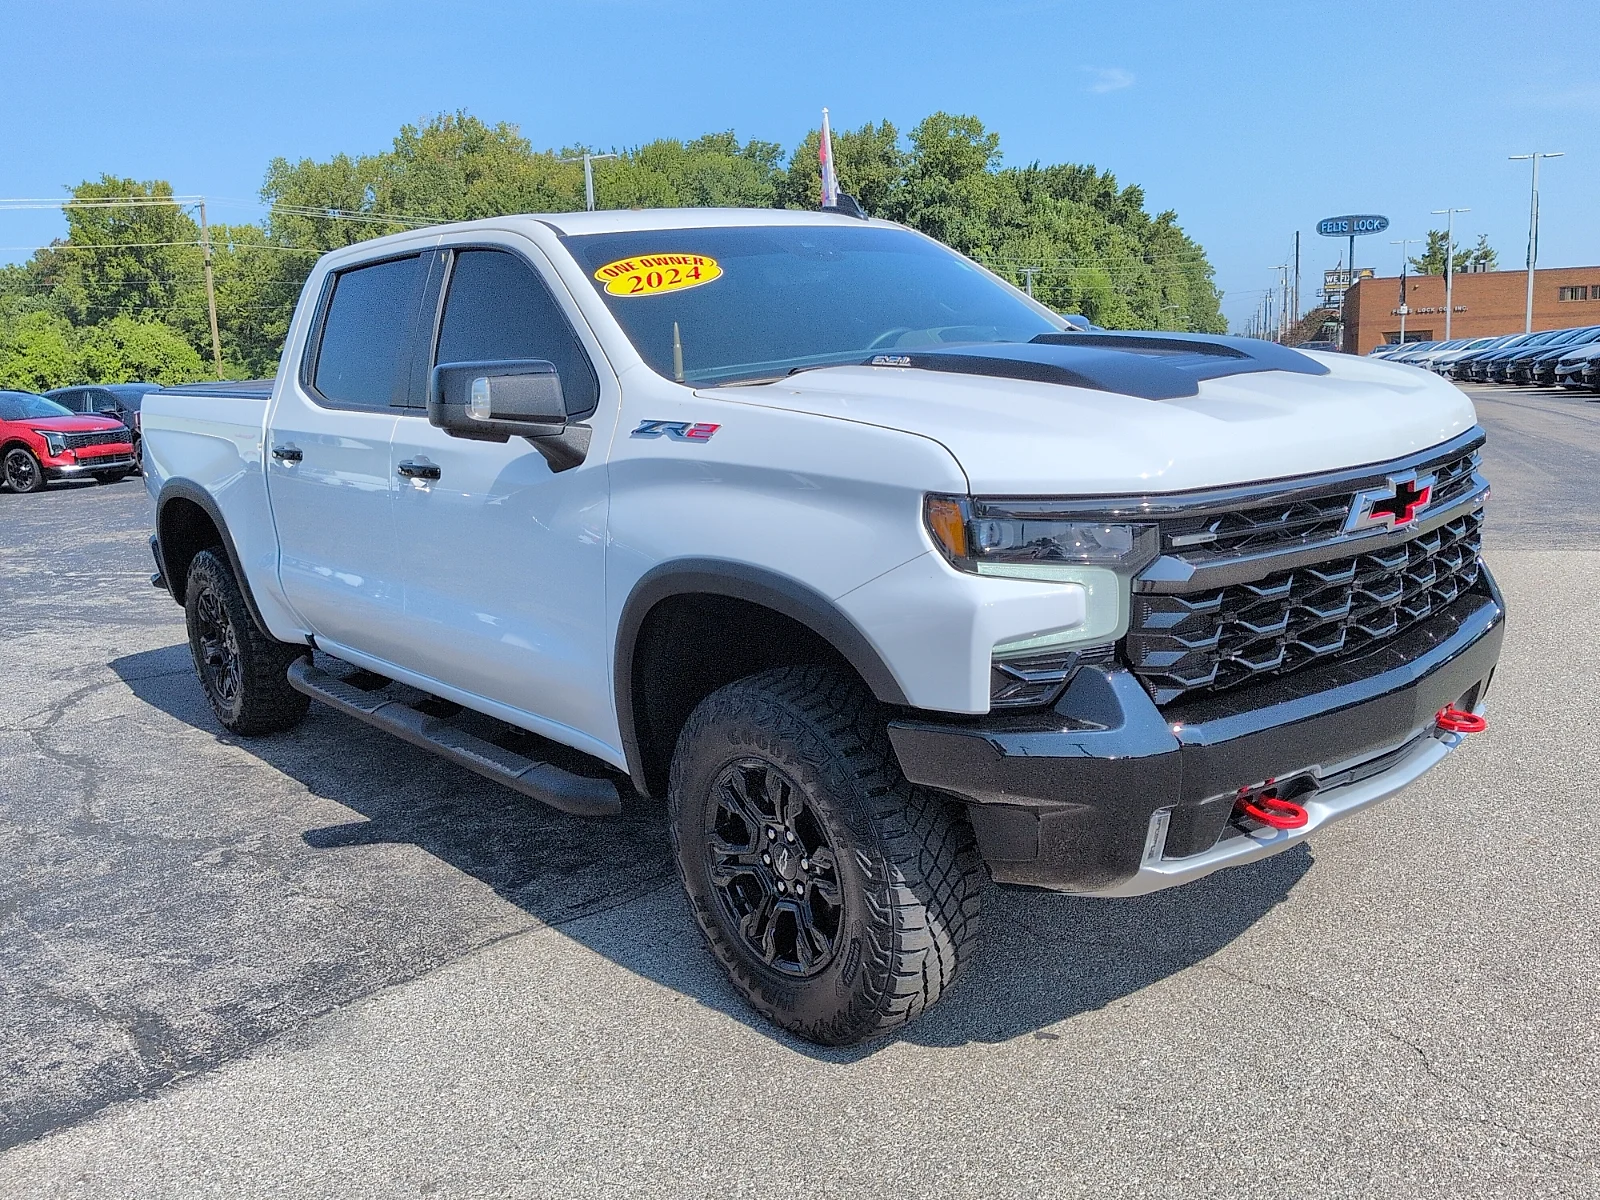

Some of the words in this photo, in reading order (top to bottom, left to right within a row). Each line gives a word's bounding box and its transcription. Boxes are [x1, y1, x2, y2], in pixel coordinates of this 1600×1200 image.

[1321, 220, 1348, 232] FELTS
[1353, 219, 1380, 231] LOCK
[603, 262, 640, 278] ONE
[640, 256, 705, 268] OWNER
[627, 266, 702, 293] 2024
[629, 419, 723, 444] ZR2
